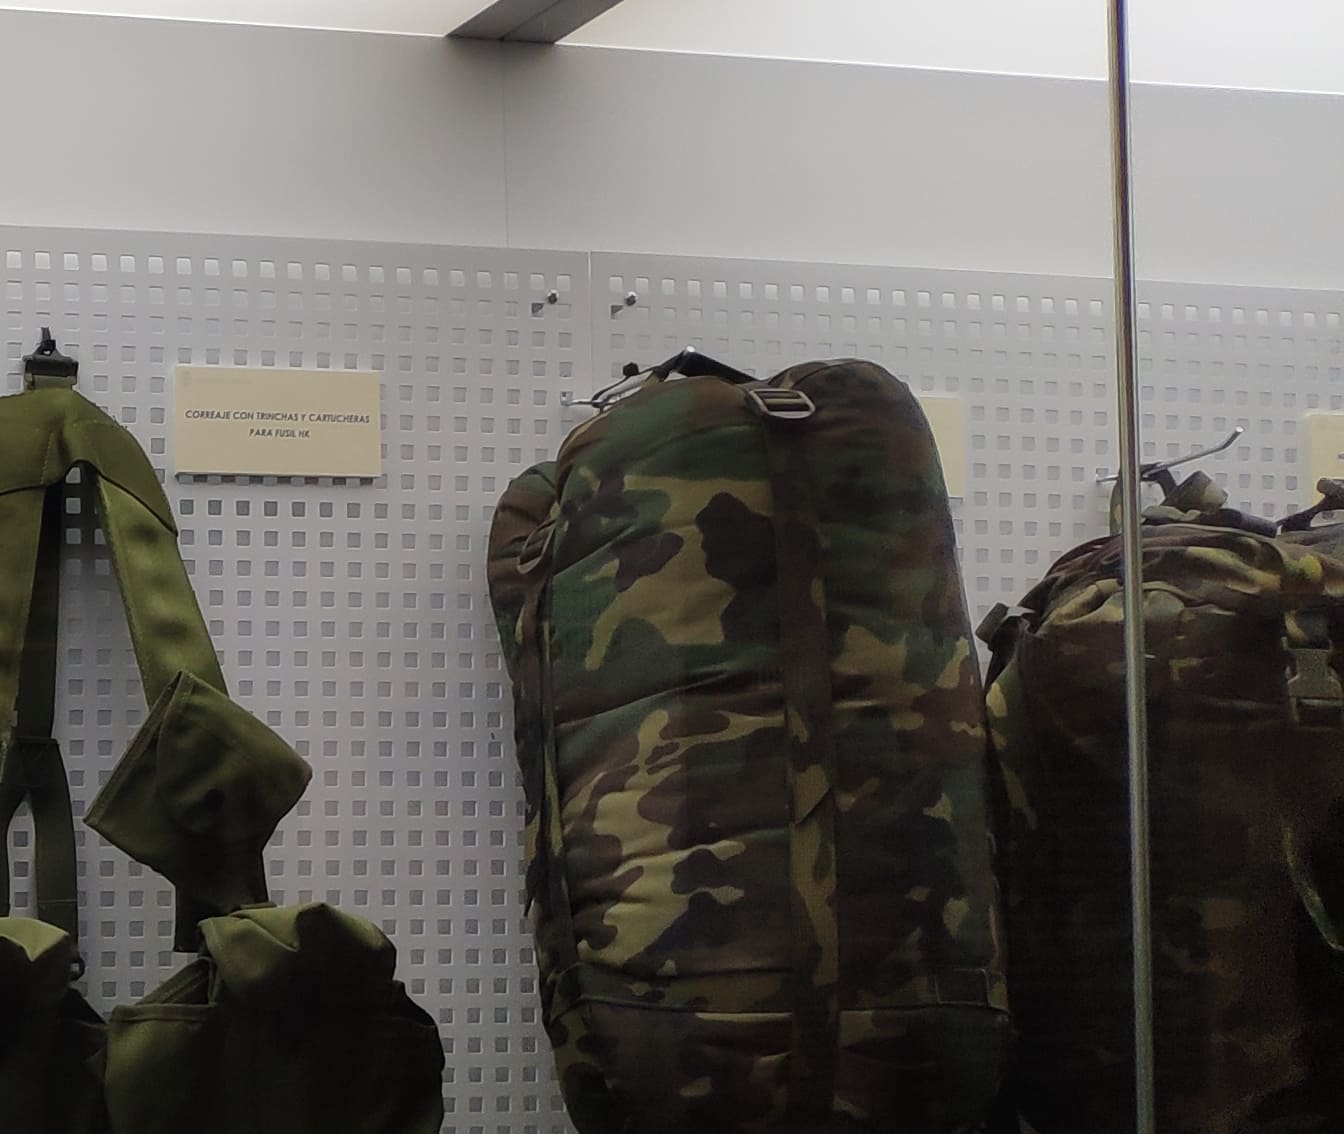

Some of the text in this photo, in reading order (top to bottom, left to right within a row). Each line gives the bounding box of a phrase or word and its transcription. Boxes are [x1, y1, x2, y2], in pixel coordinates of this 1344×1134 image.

[185, 409, 231, 420] CORREAJE
[232, 411, 254, 421] CON
[256, 411, 298, 422] TRINCHAS
[309, 413, 370, 424] CARTUCHERAS
[249, 428, 310, 439] PARA FUSIL HK
